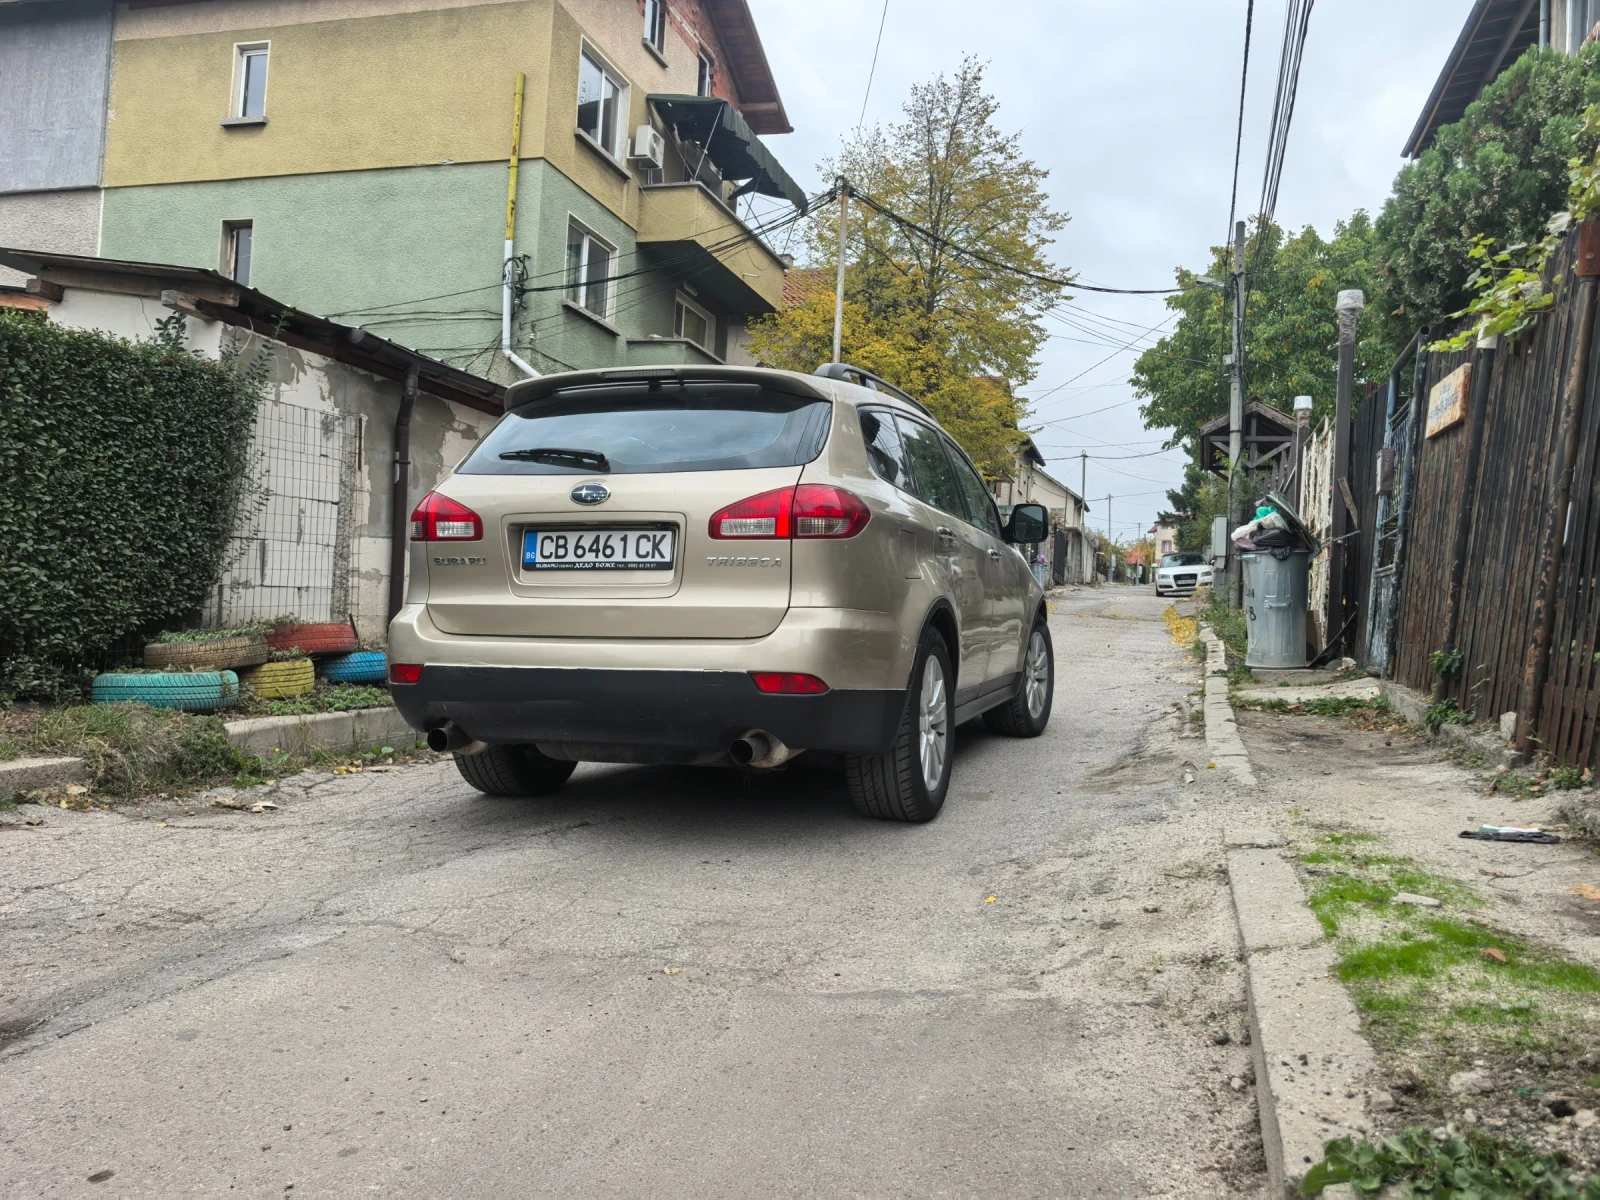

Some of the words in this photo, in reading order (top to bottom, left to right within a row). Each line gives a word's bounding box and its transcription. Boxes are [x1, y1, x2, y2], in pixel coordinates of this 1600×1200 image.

[540, 535, 568, 559] CB
[573, 534, 628, 559] 6461
[635, 534, 667, 559] CK
[433, 556, 487, 566] SUBARU
[706, 557, 782, 567] TRIBECA
